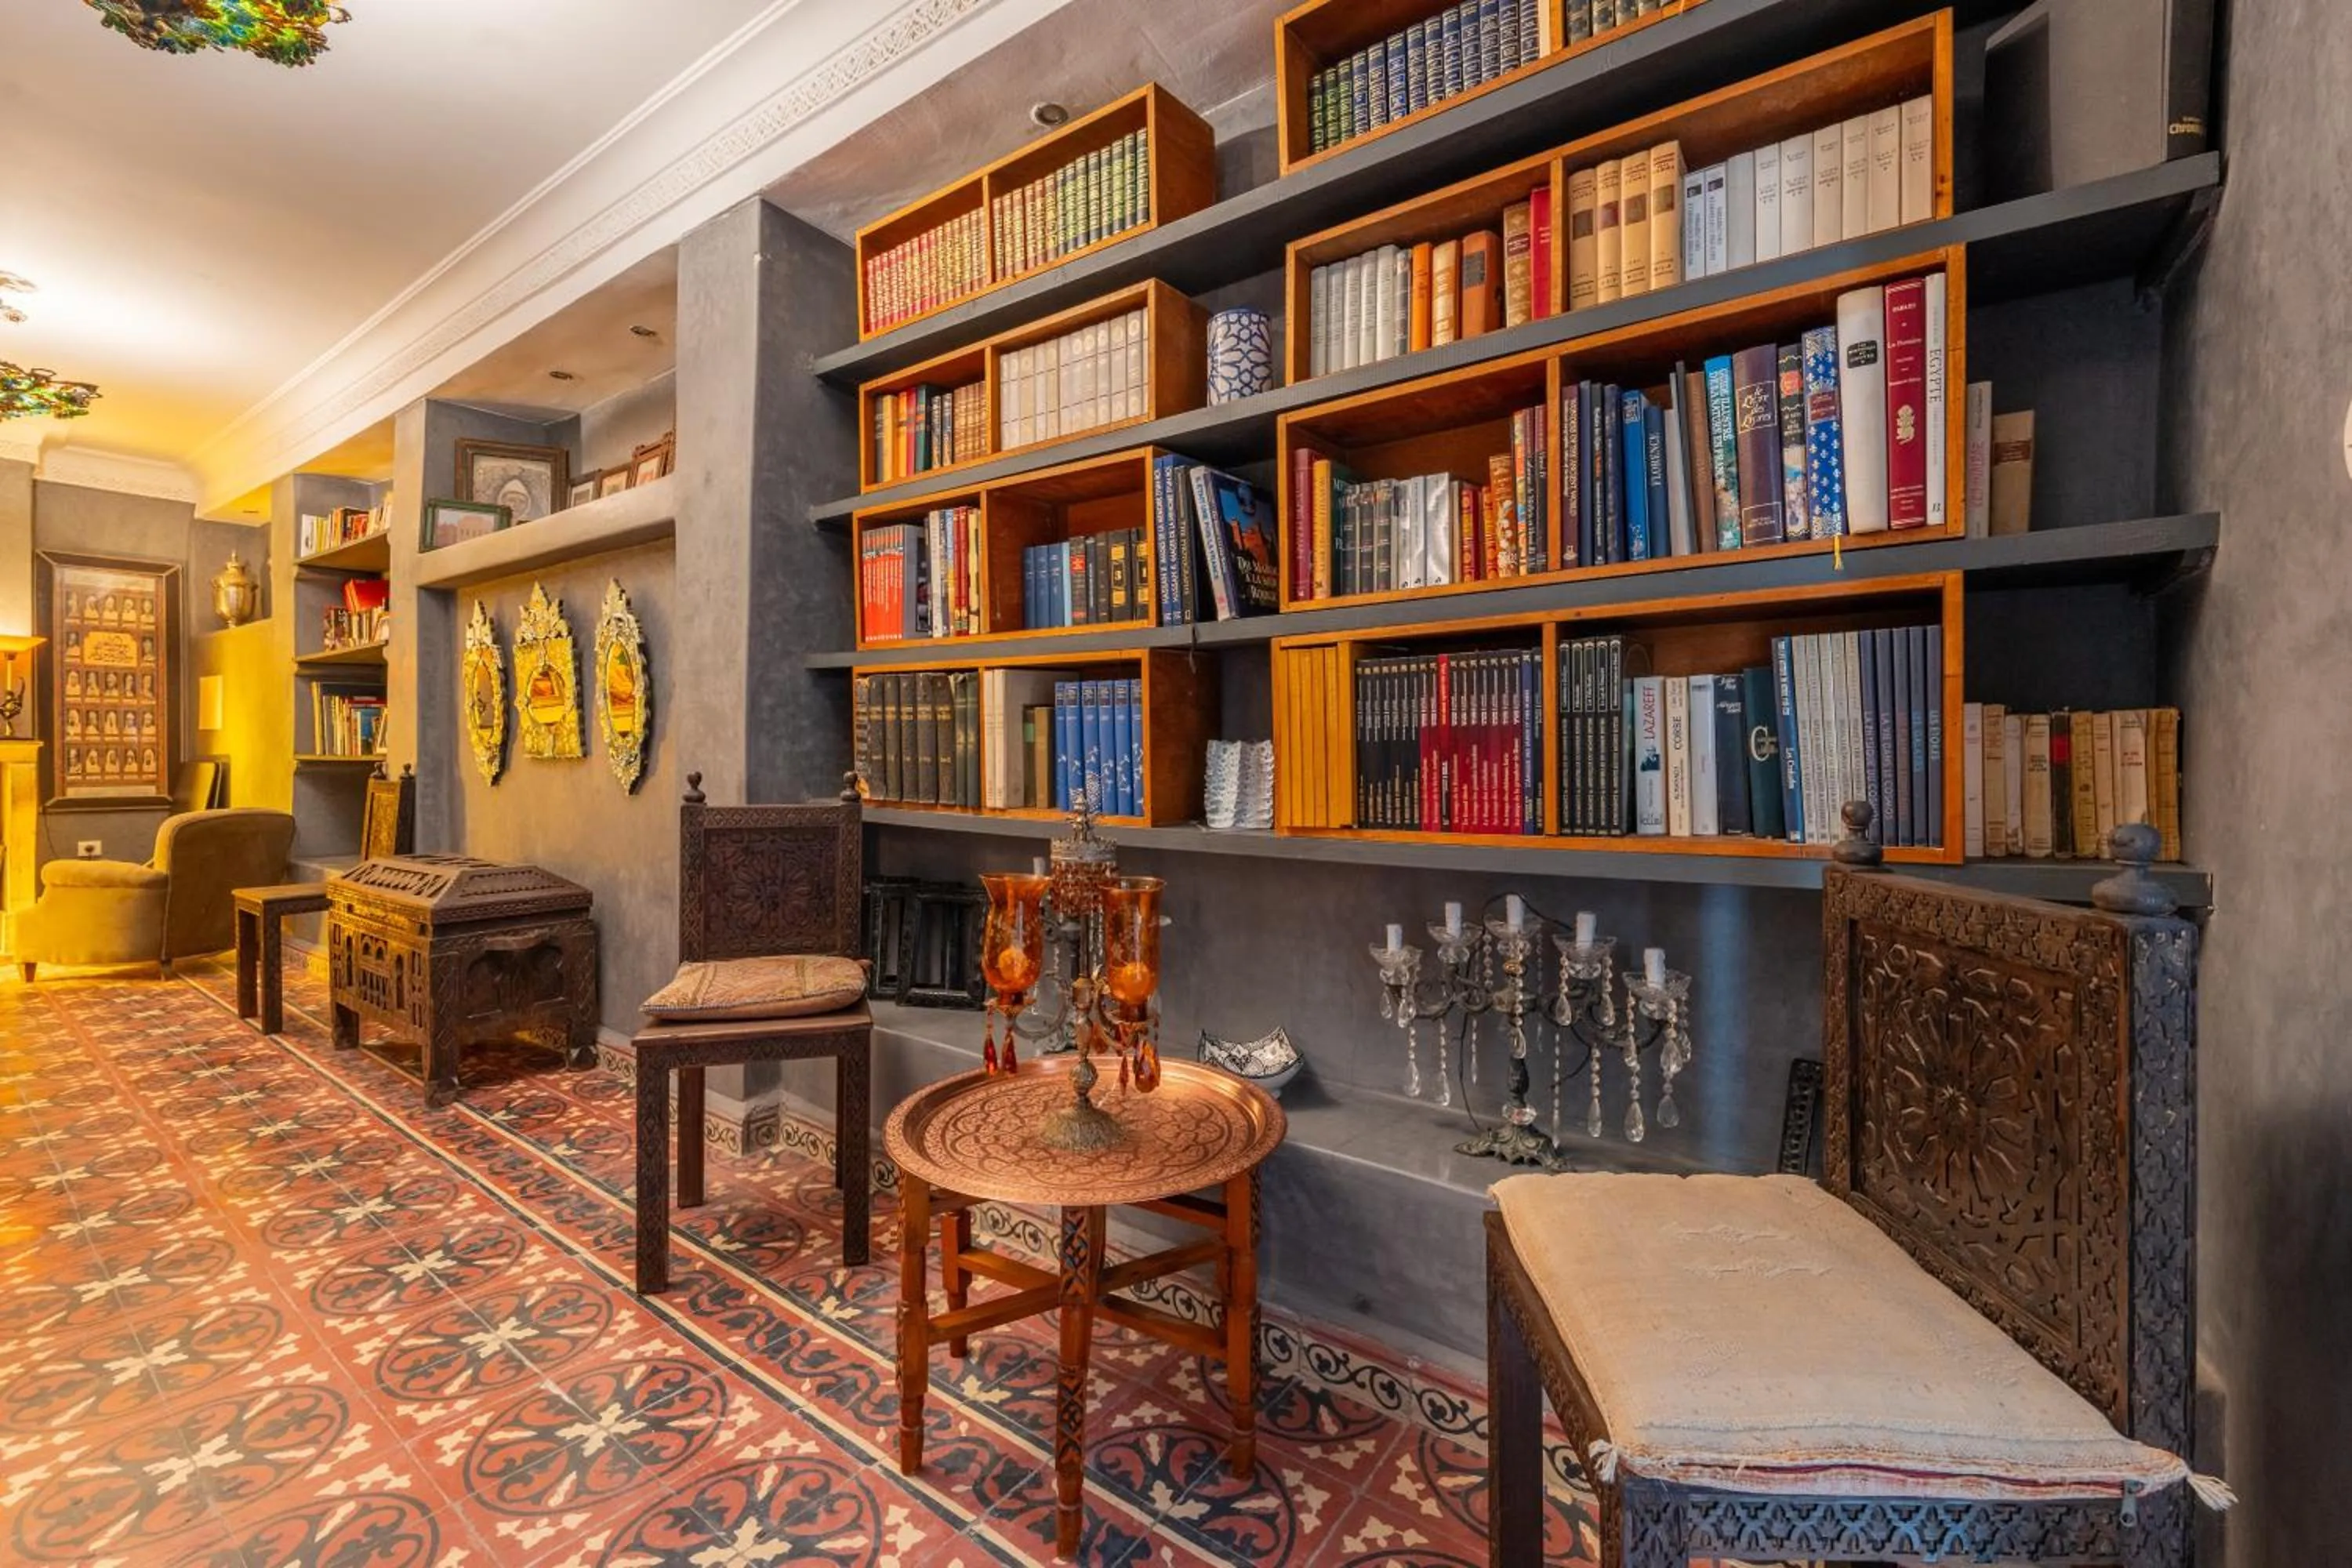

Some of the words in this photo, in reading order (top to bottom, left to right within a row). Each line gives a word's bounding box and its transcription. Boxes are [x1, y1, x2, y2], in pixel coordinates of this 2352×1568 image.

[1929, 349, 1943, 404] EGYPTE
[1650, 431, 1662, 487] FLORENCE
[1642, 685, 1656, 739] LAZAREFF
[1880, 713, 1890, 724] LA
[1672, 715, 1683, 750] CORSE
[1882, 728, 1891, 740] VIE
[1882, 742, 1892, 767] DANS
[1884, 780, 1893, 820] COSMOS
